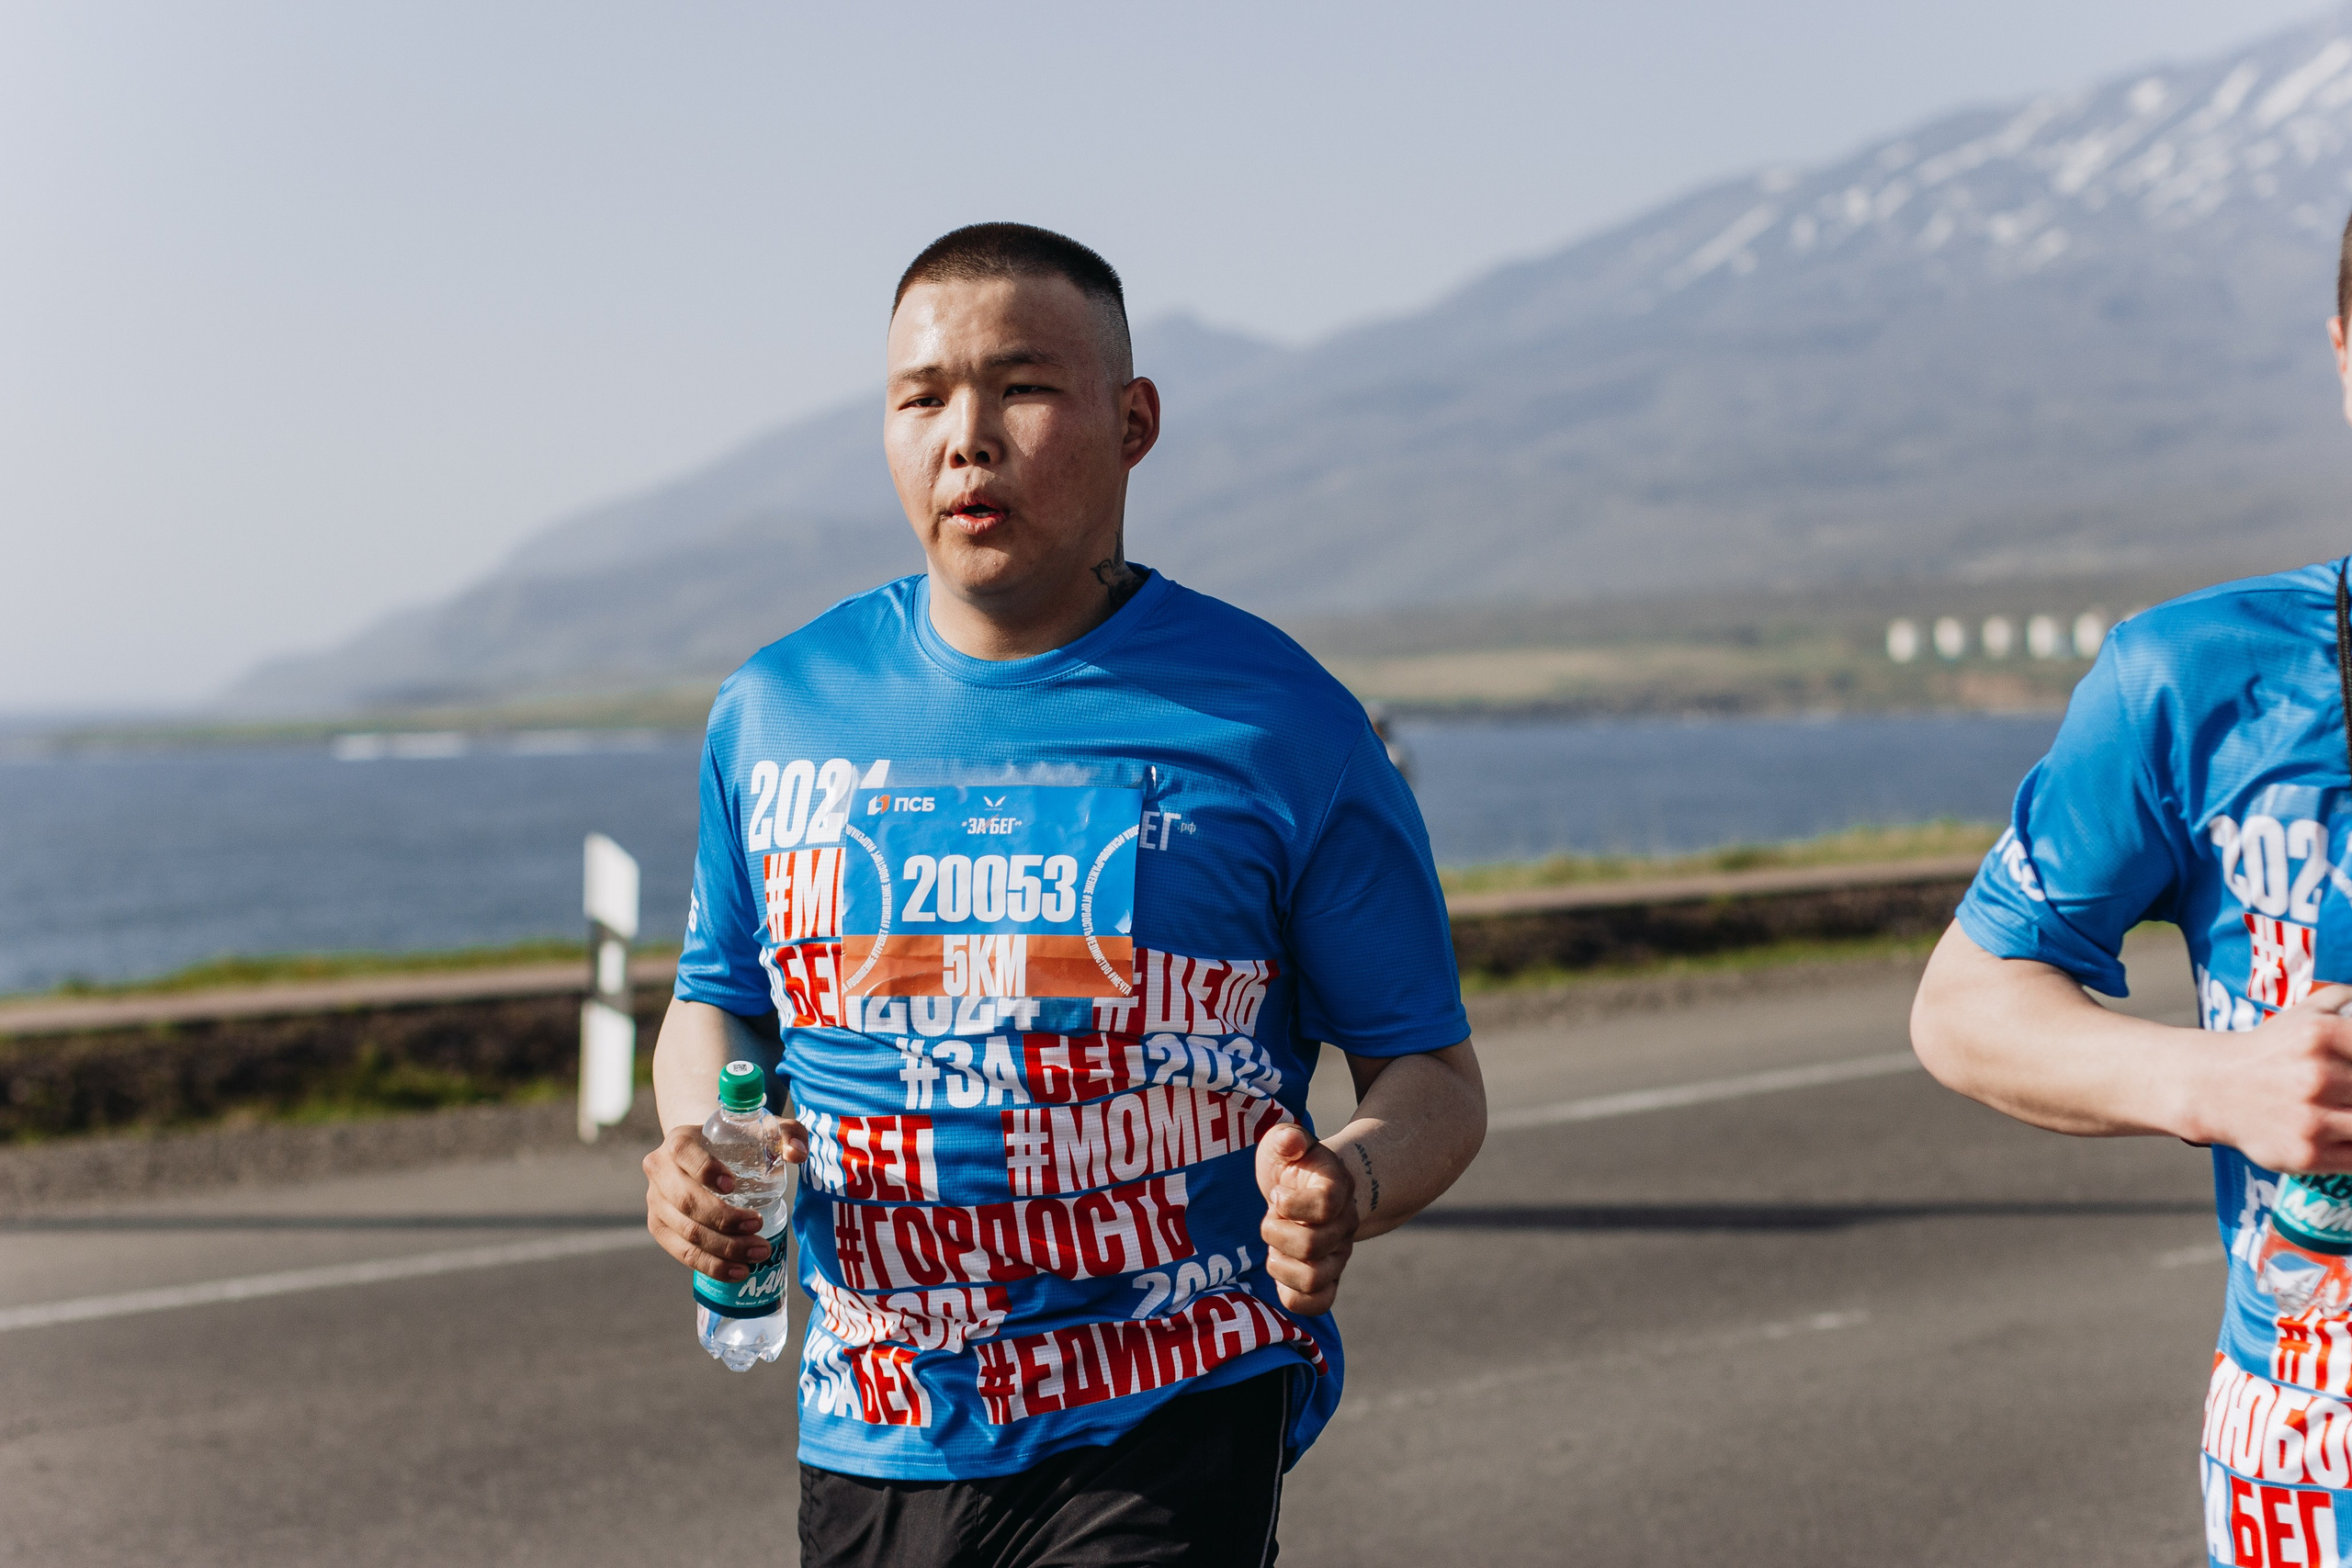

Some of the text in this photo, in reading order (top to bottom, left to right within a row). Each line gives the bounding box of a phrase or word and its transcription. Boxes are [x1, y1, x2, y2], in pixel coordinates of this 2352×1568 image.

[894, 796, 935, 813] ПСБ
[901, 855, 1079, 923] 20053
[834, 1176, 1195, 1290] #ГОРДОСТЬ
